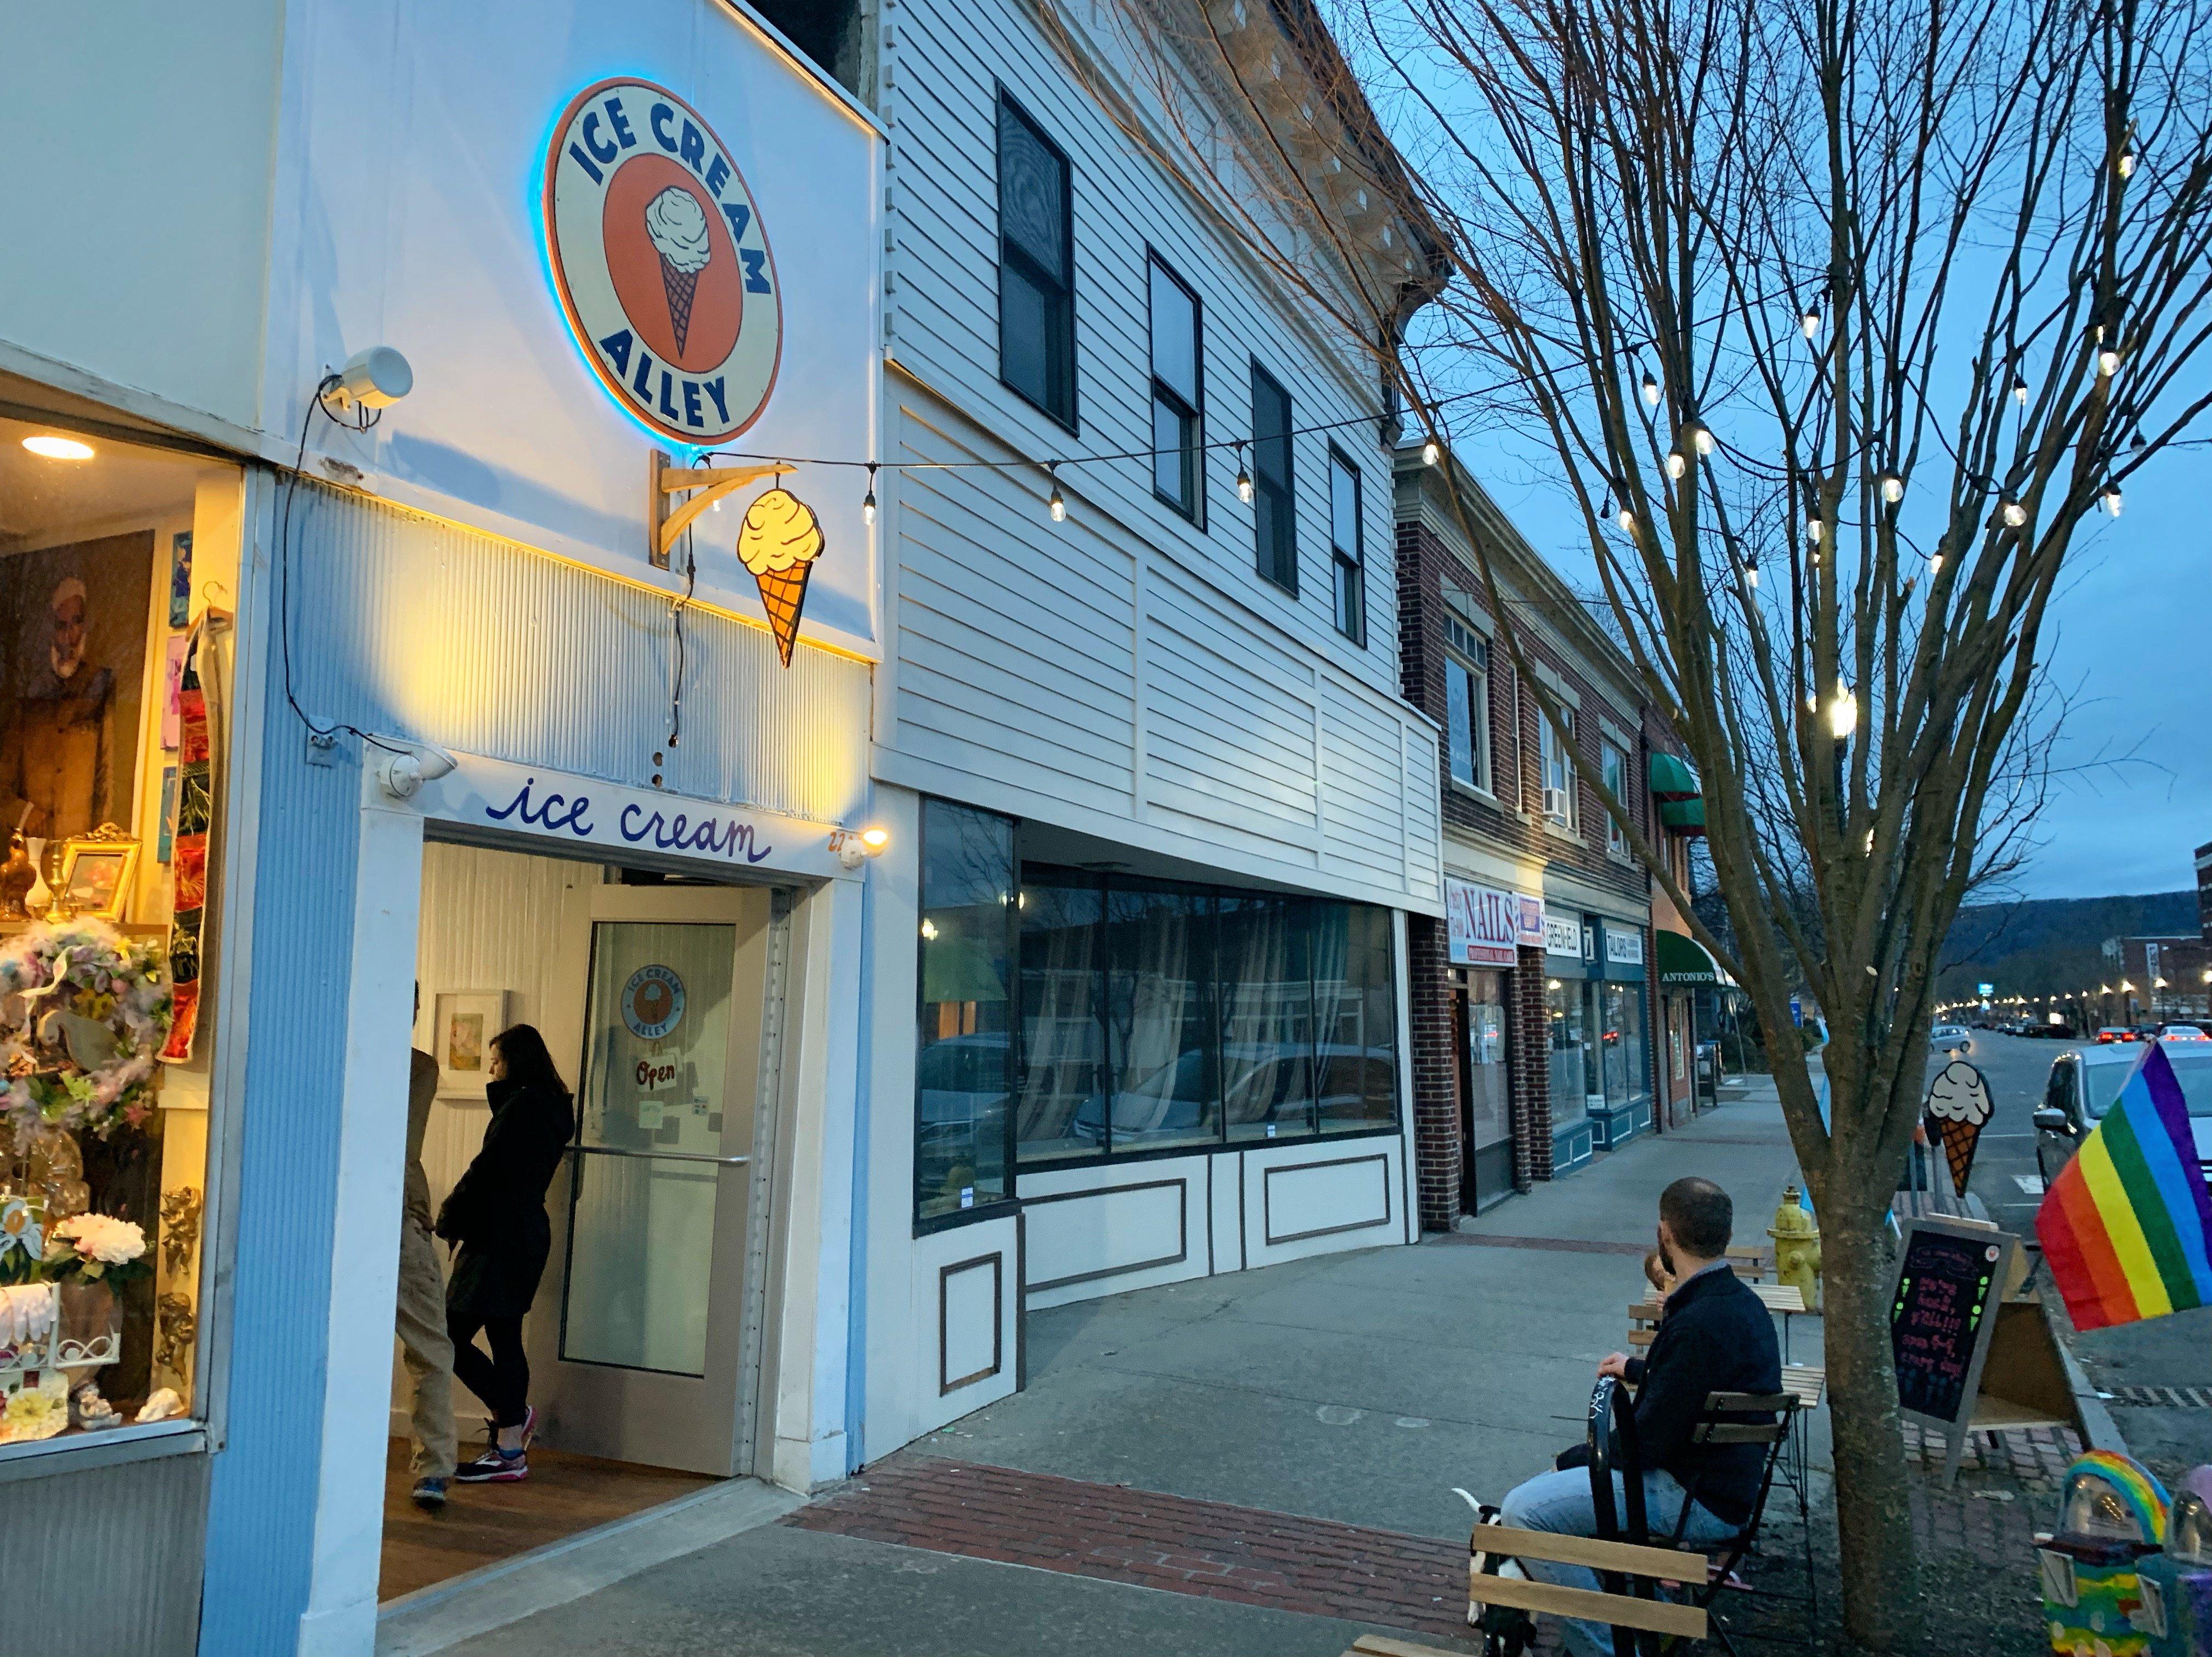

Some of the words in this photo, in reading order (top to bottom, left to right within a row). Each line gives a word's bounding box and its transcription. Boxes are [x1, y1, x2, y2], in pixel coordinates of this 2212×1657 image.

[569, 97, 636, 185] ICE
[650, 103, 771, 294] CREAM
[599, 329, 730, 427] ALLEY
[486, 777, 594, 836] ice
[620, 804, 771, 863] cream
[1462, 886, 1515, 943] NAILS
[646, 968, 680, 994] CREAM
[1662, 972, 1714, 982] ANTONIO'S
[633, 1022, 668, 1036] ALLEY
[636, 1061, 675, 1090] Open
